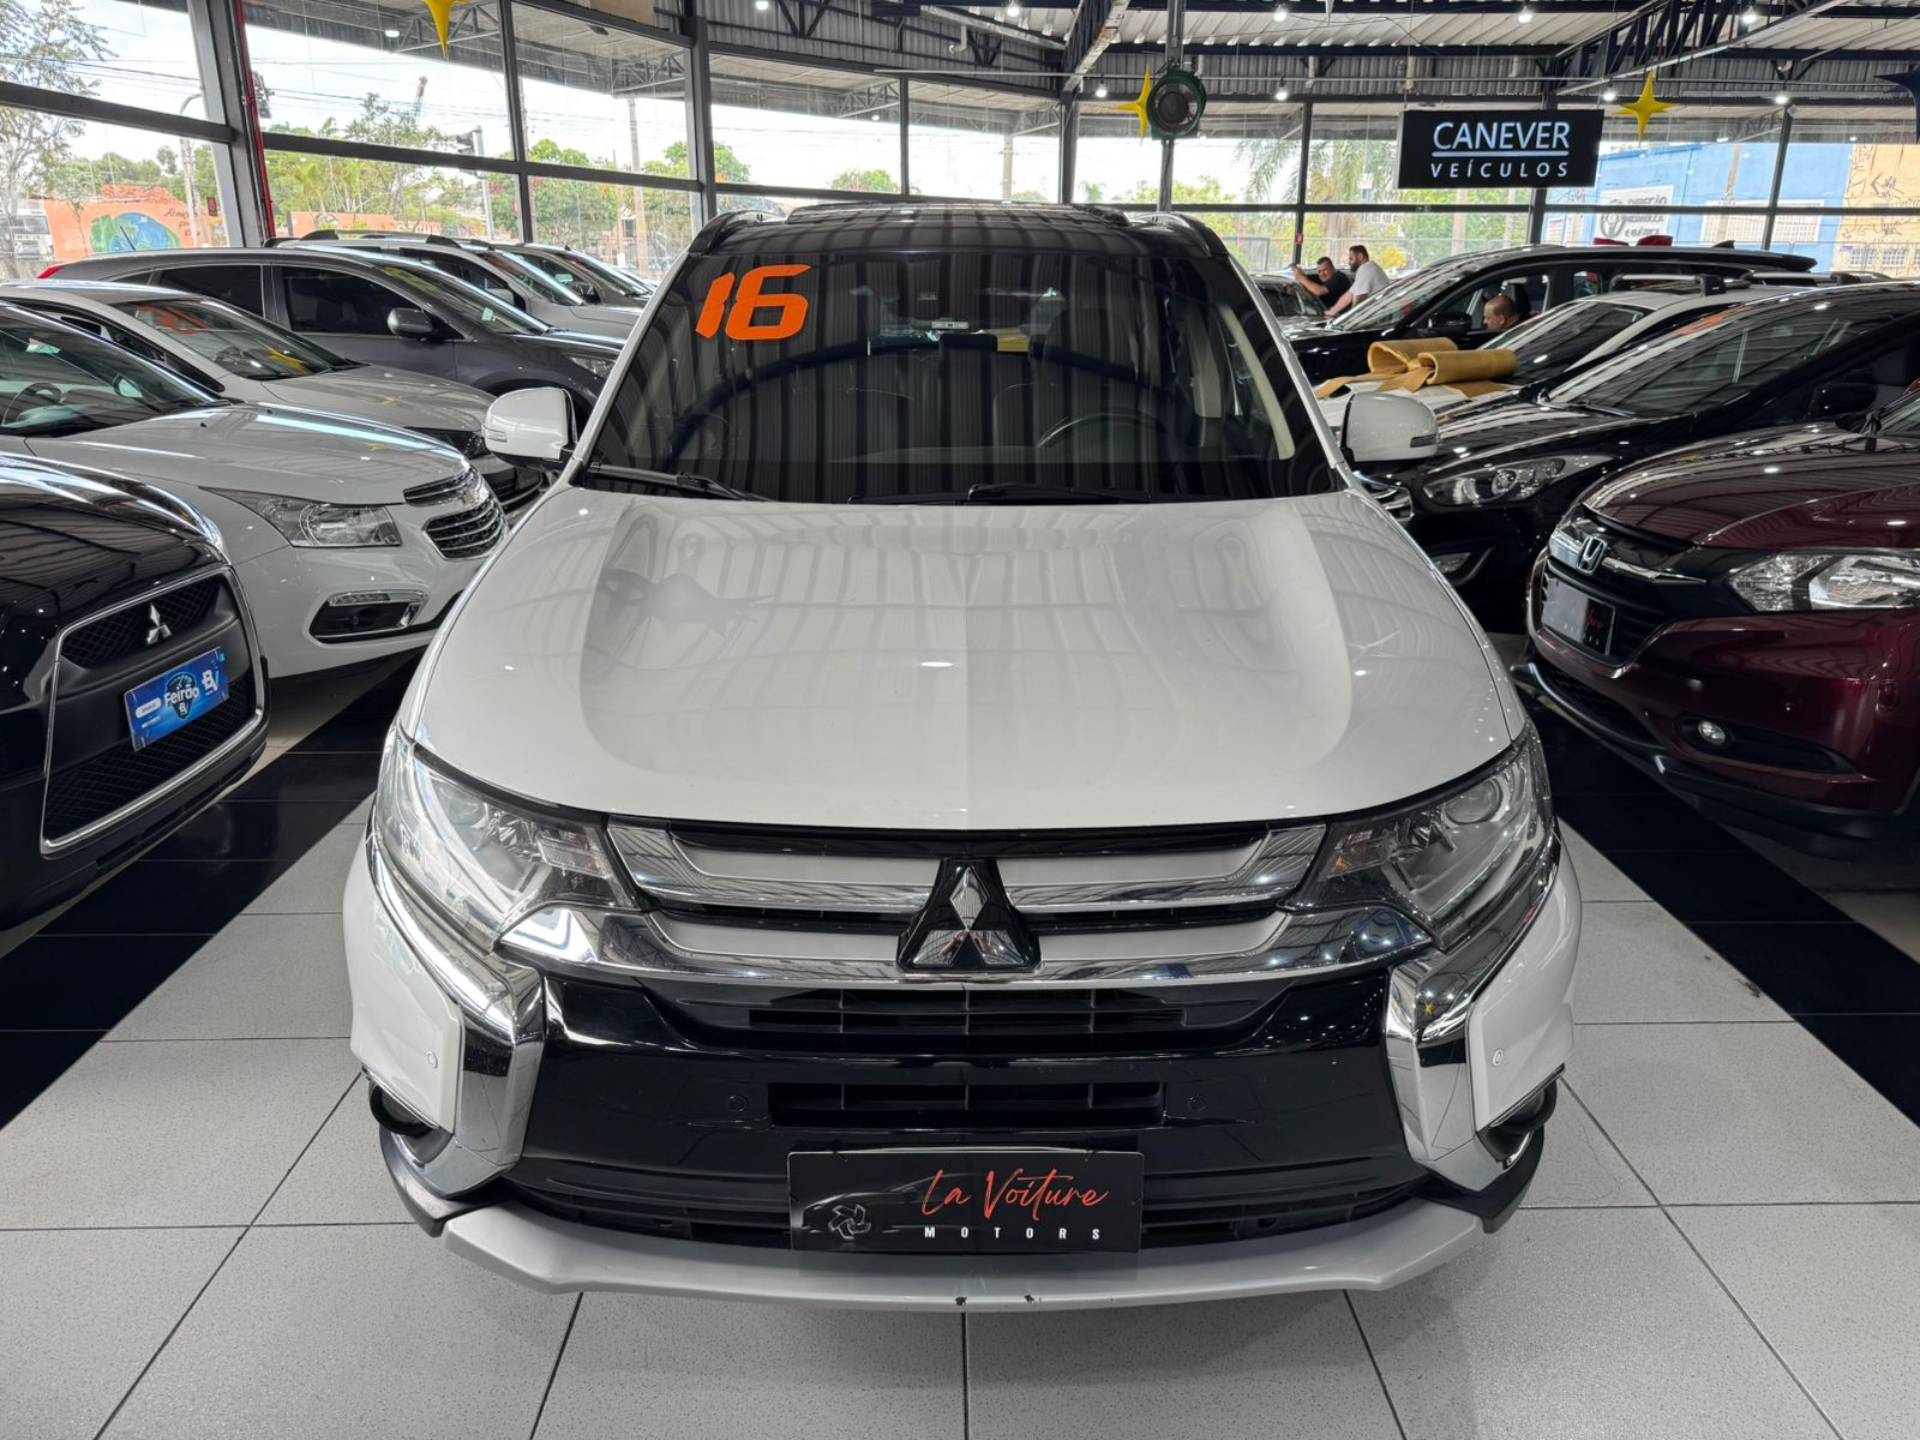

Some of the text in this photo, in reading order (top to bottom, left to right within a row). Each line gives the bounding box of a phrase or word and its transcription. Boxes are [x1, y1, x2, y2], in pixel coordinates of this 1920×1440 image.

[1433, 121, 1571, 150] CANEVER
[1430, 159, 1568, 178] VEÍCULOS
[695, 263, 813, 341] 16
[921, 1168, 1109, 1221] La Voiture
[924, 1226, 1101, 1240] MOTORS
